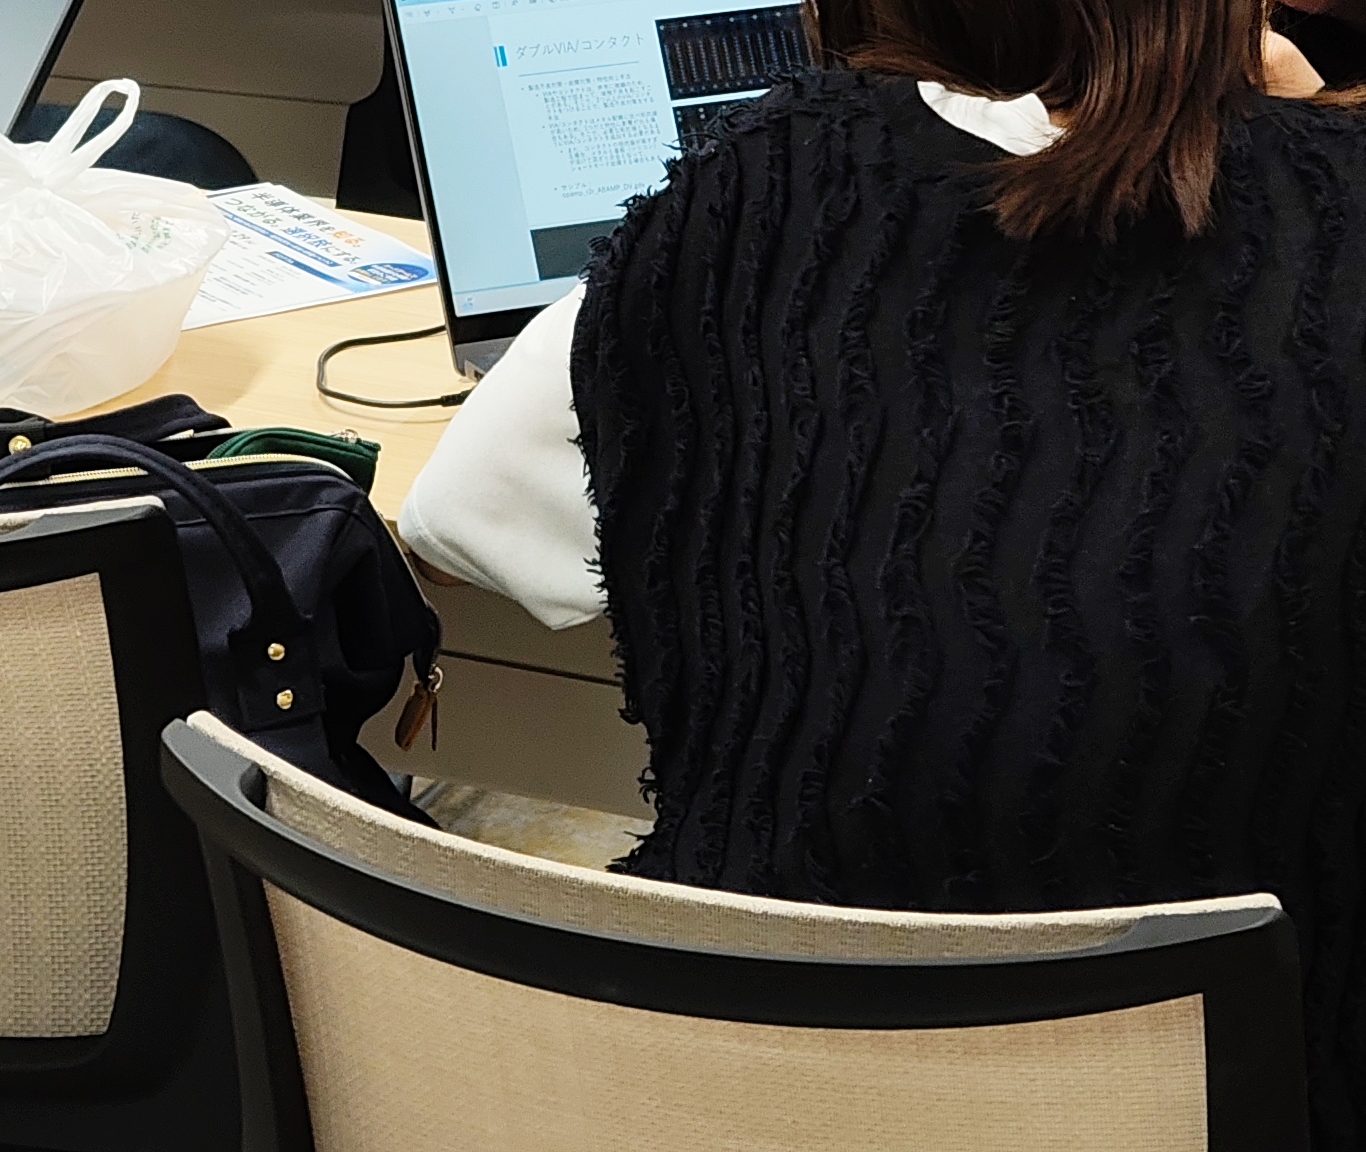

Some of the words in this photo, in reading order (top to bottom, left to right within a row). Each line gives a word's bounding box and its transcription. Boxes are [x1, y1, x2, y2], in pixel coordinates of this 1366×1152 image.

[517, 33, 644, 59] ダブルVIA/コンタクト
